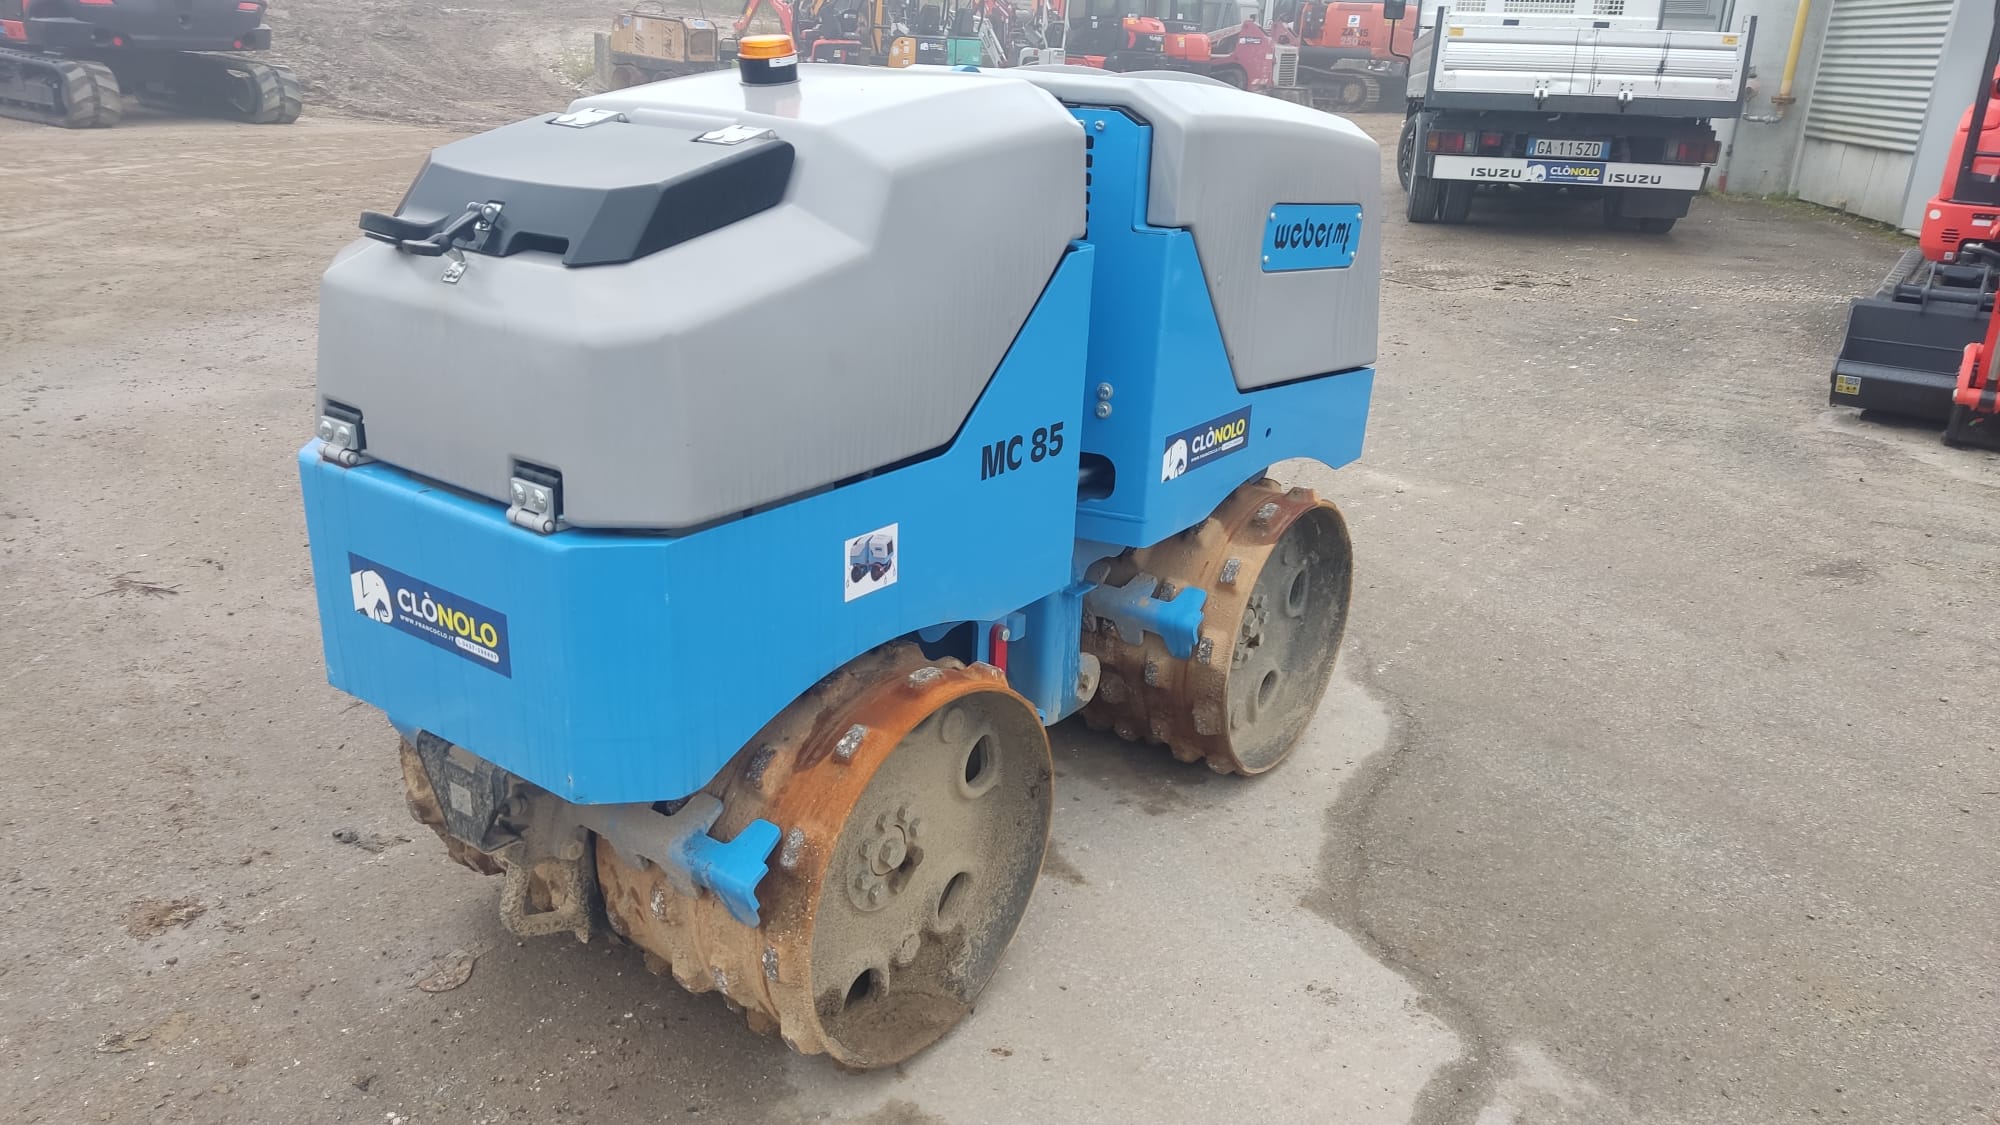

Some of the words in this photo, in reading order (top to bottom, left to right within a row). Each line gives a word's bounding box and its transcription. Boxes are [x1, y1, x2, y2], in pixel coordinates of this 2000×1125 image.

[1537, 141, 1552, 154] GA
[1560, 142, 1600, 156] 115ZD
[1471, 167, 1521, 178] ISUZU
[1550, 165, 1600, 176] CLÒNOLO
[1609, 173, 1661, 185] ISUZU
[1192, 418, 1246, 454] CLÒNOLO
[981, 440, 1023, 481] MC
[1030, 421, 1064, 463] 85
[397, 588, 498, 648] CLÒNOLO
